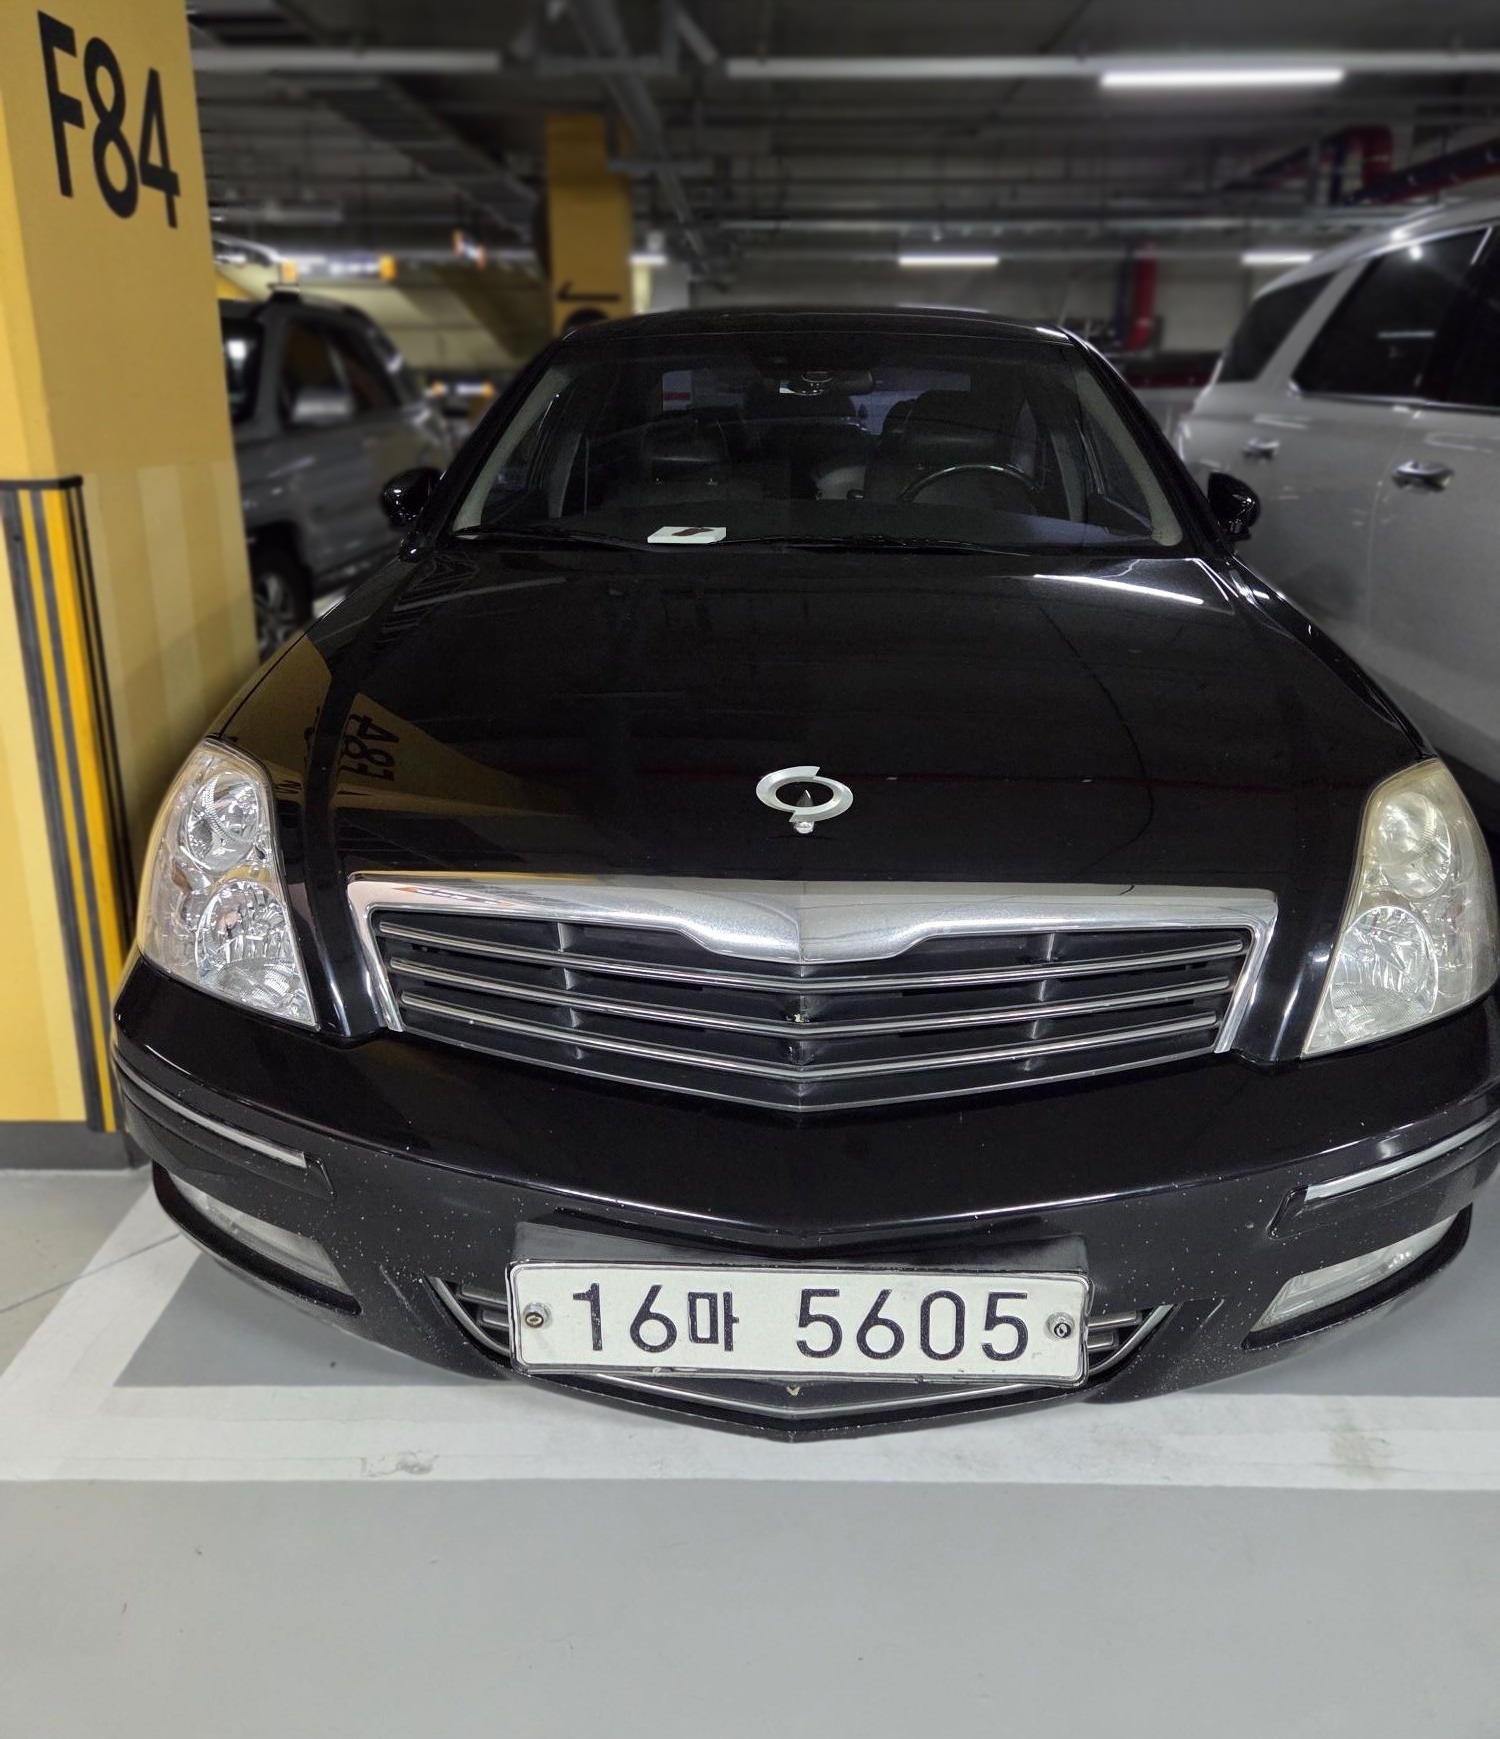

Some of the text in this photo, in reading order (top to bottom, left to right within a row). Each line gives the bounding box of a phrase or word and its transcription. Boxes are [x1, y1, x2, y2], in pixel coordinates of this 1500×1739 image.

[38, 10, 180, 229] F84
[572, 1283, 1029, 1362] 16마 5605
